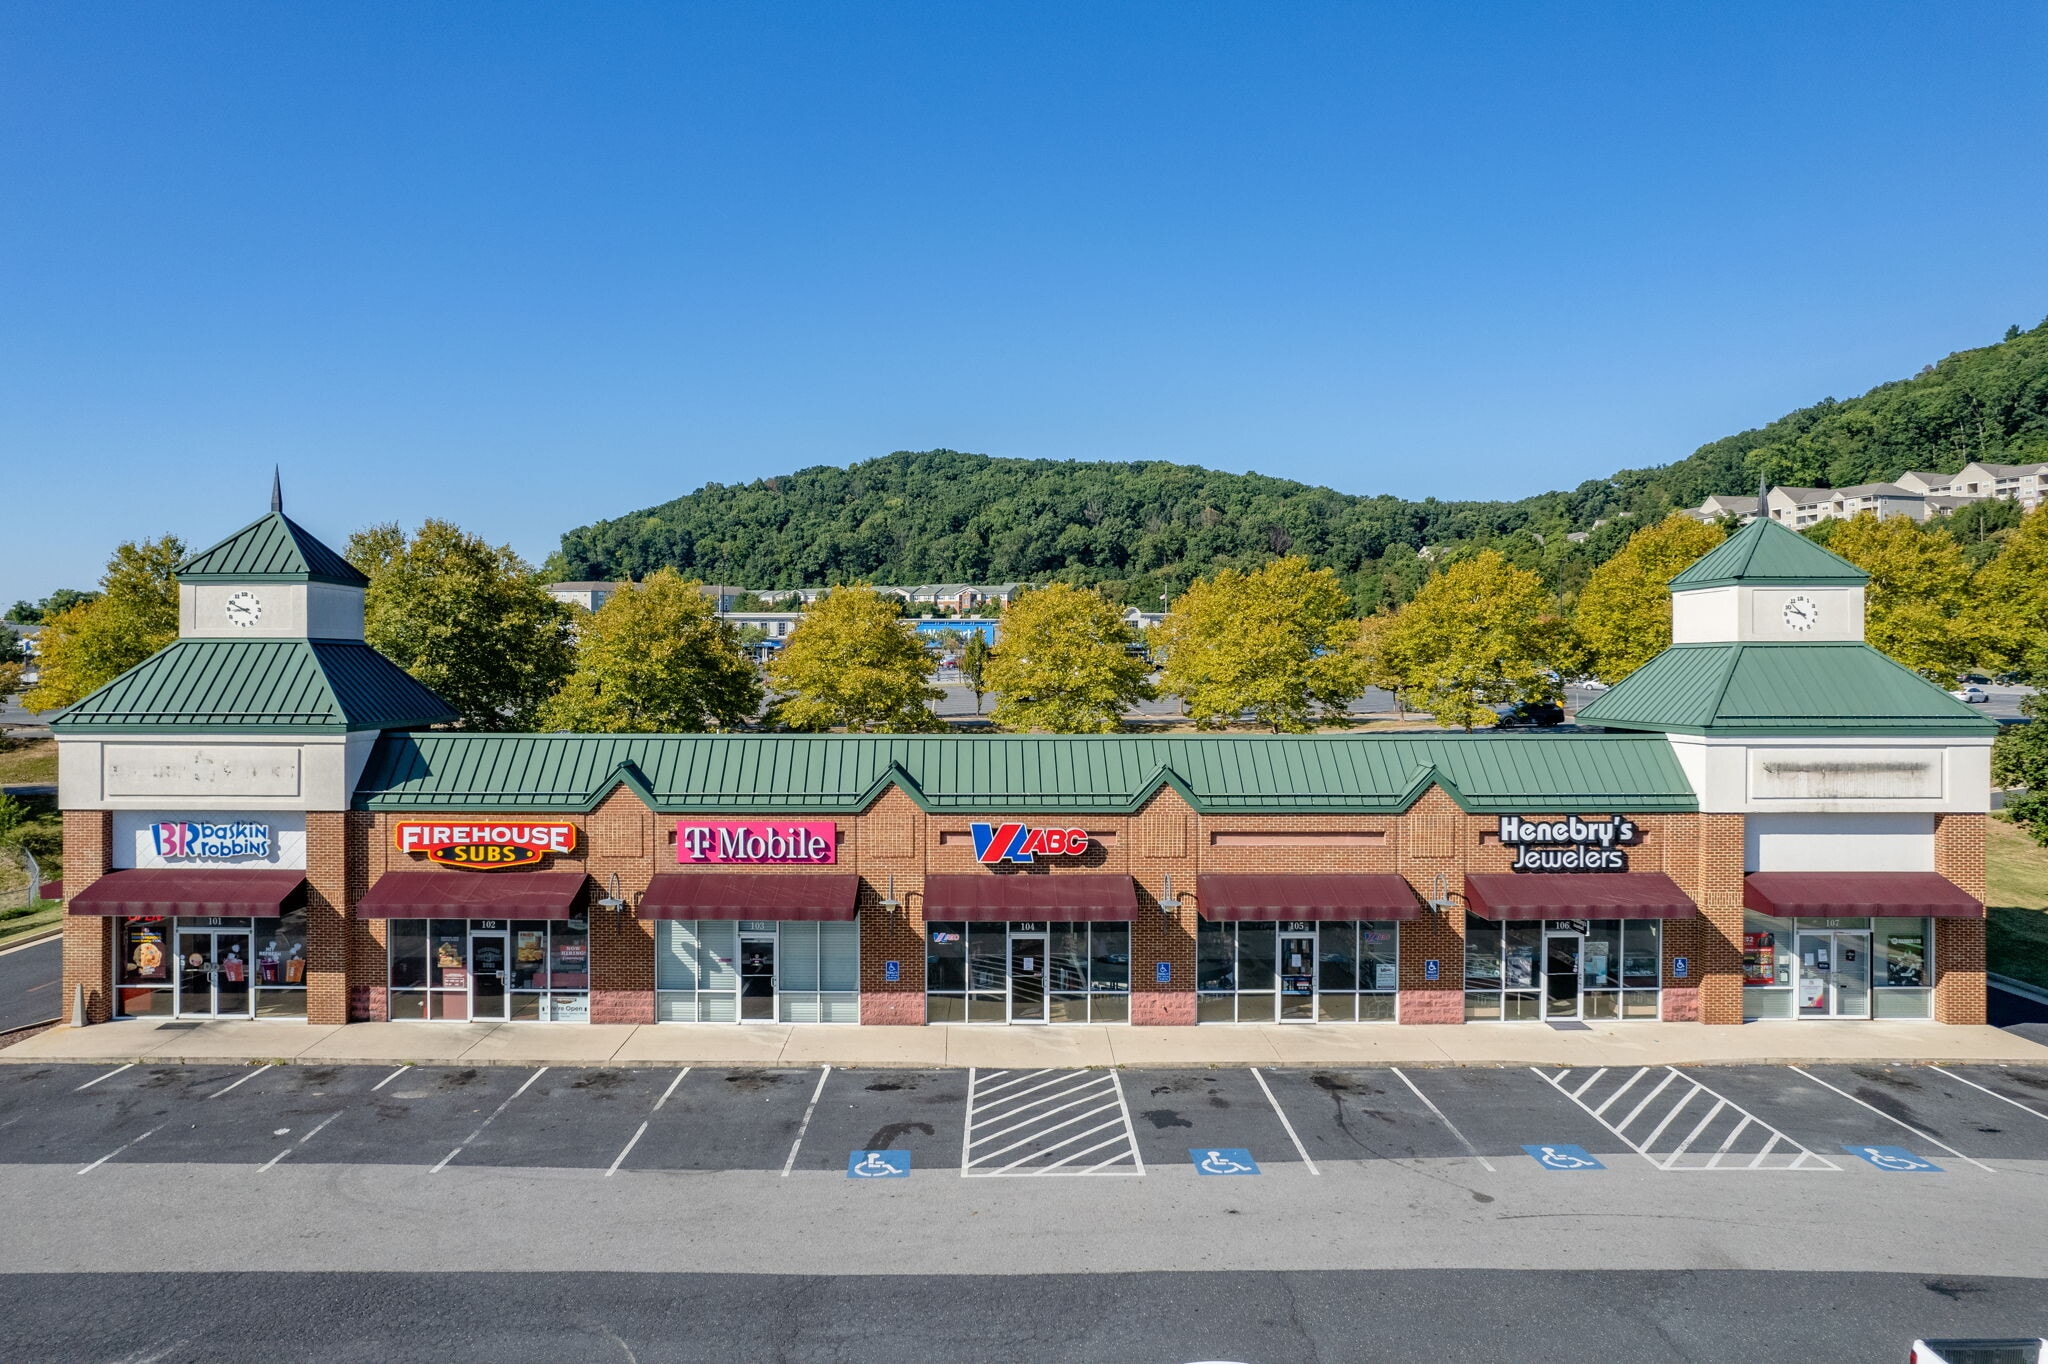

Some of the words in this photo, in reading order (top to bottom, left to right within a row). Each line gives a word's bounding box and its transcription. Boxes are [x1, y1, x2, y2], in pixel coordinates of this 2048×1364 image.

[151, 821, 200, 856] BR
[201, 821, 267, 840] baskin
[1501, 816, 1634, 847] Henebry's
[201, 839, 267, 857] robbins
[402, 825, 569, 854] FIREHOUSE
[684, 826, 710, 859] T
[716, 826, 826, 859] Mobile
[454, 845, 516, 862] SUBS
[1513, 845, 1623, 868] Jewelers
[208, 917, 222, 926] 101
[481, 920, 496, 929] 102
[751, 921, 765, 930] 103
[1020, 922, 1035, 931] 104
[1289, 921, 1304, 930] 105
[1556, 921, 1570, 930] 106
[1826, 919, 1840, 927] 107
